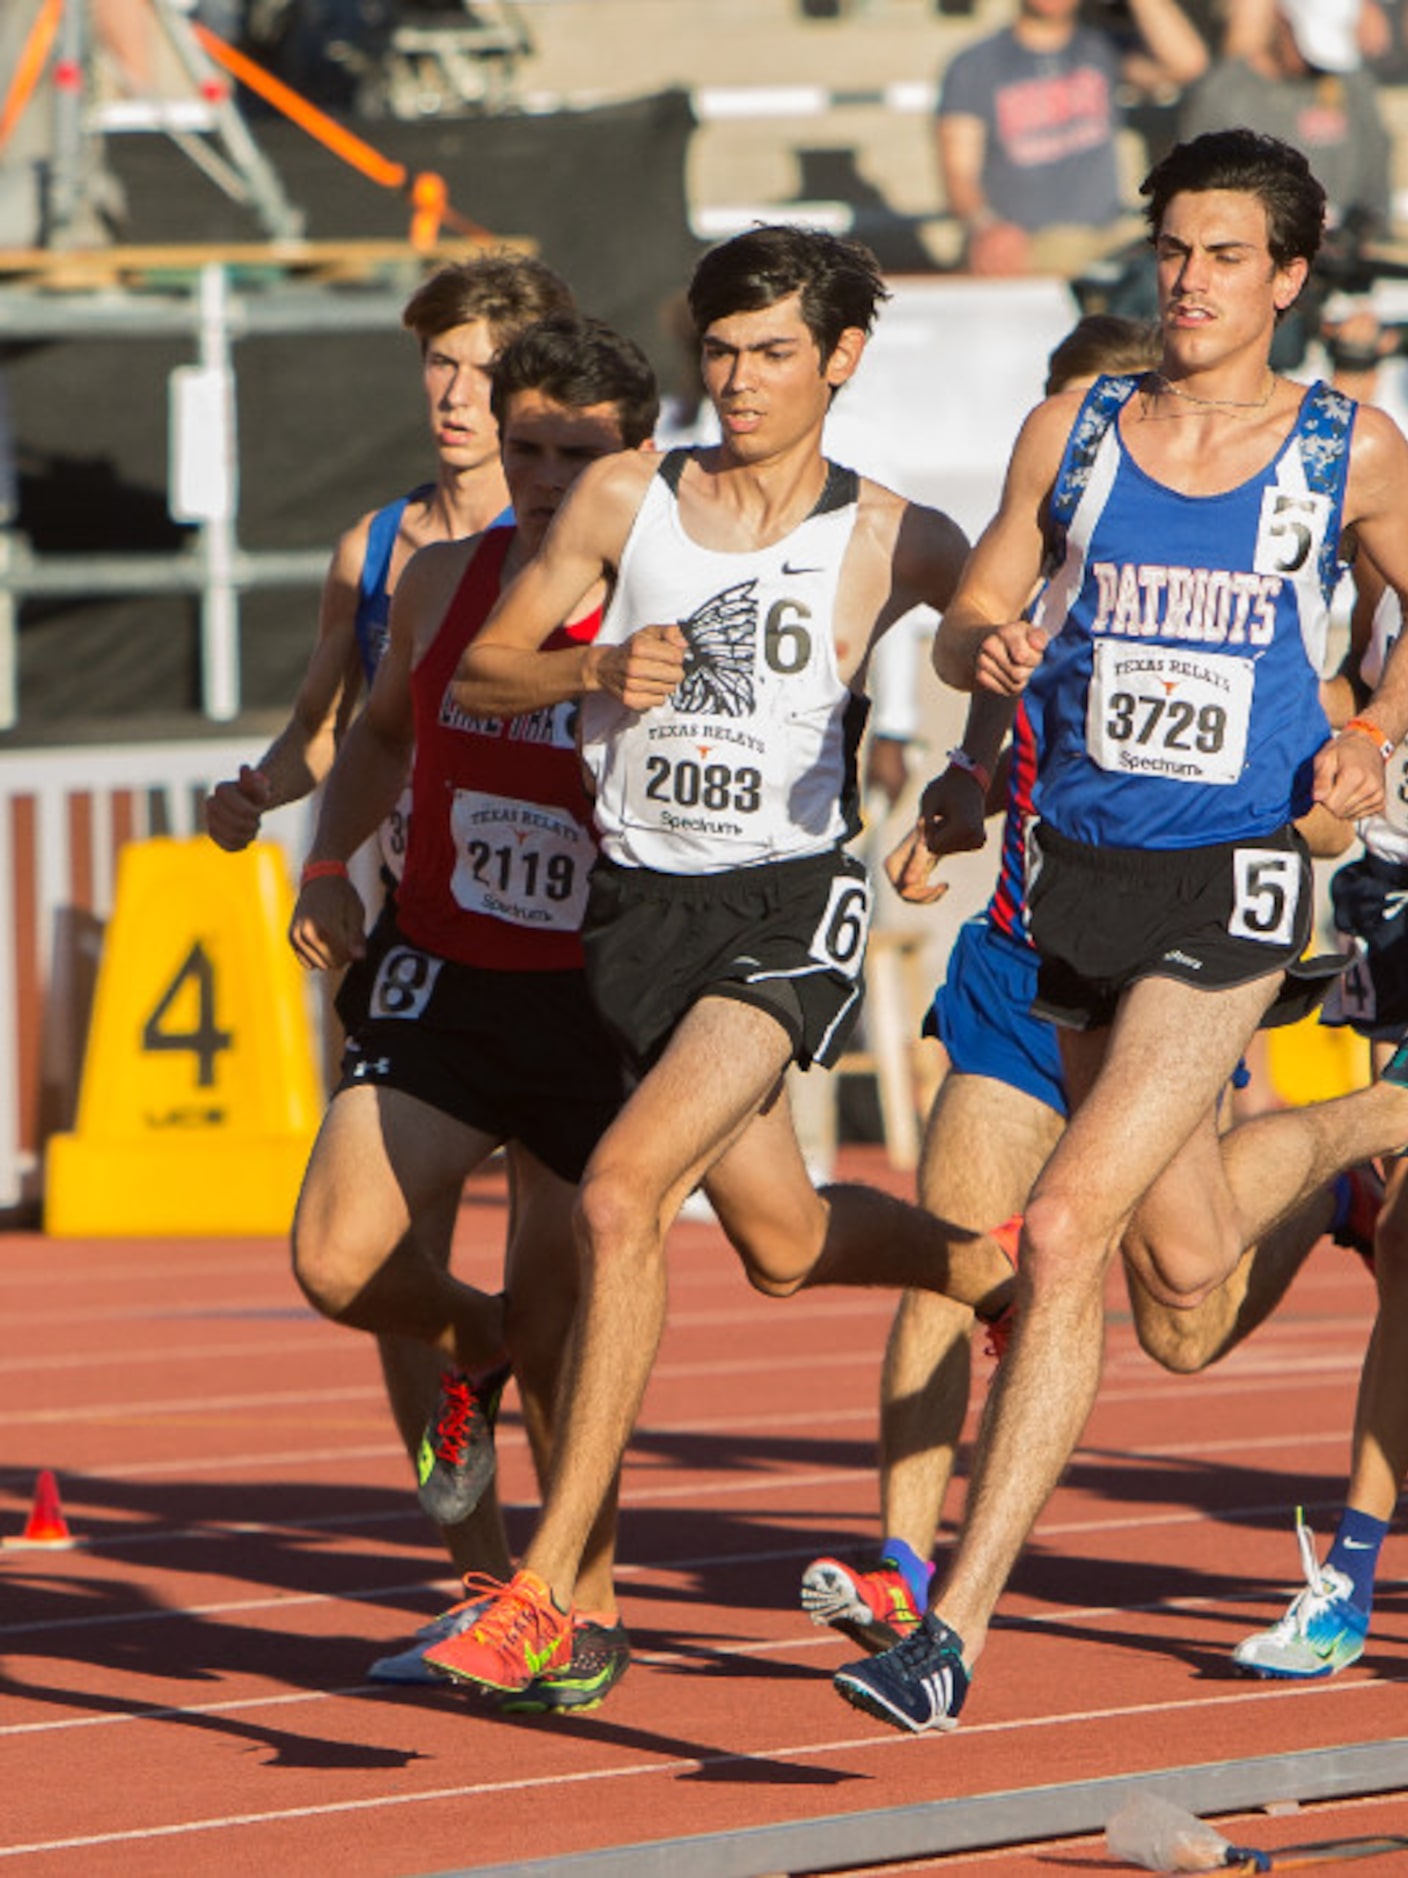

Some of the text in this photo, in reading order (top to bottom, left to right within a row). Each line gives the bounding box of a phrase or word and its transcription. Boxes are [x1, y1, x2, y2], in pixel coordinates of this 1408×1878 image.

[1270, 495, 1316, 572] 5
[1091, 562, 1284, 646] PATRIOTS
[764, 599, 812, 675] 6
[1115, 658, 1231, 693] TEXAS RELAYS
[648, 724, 765, 754] TEXAS RELAYS
[1106, 692, 1227, 754] 3729
[645, 754, 763, 814] 2083
[1118, 750, 1197, 776] Spectrum
[471, 807, 579, 842] TEXAS RELAYS
[660, 810, 736, 836] Spectrum
[467, 839, 575, 902] 2119
[1243, 860, 1287, 931] 5
[825, 888, 867, 962] 6
[142, 938, 231, 1088] 4
[380, 953, 429, 1012] 8
